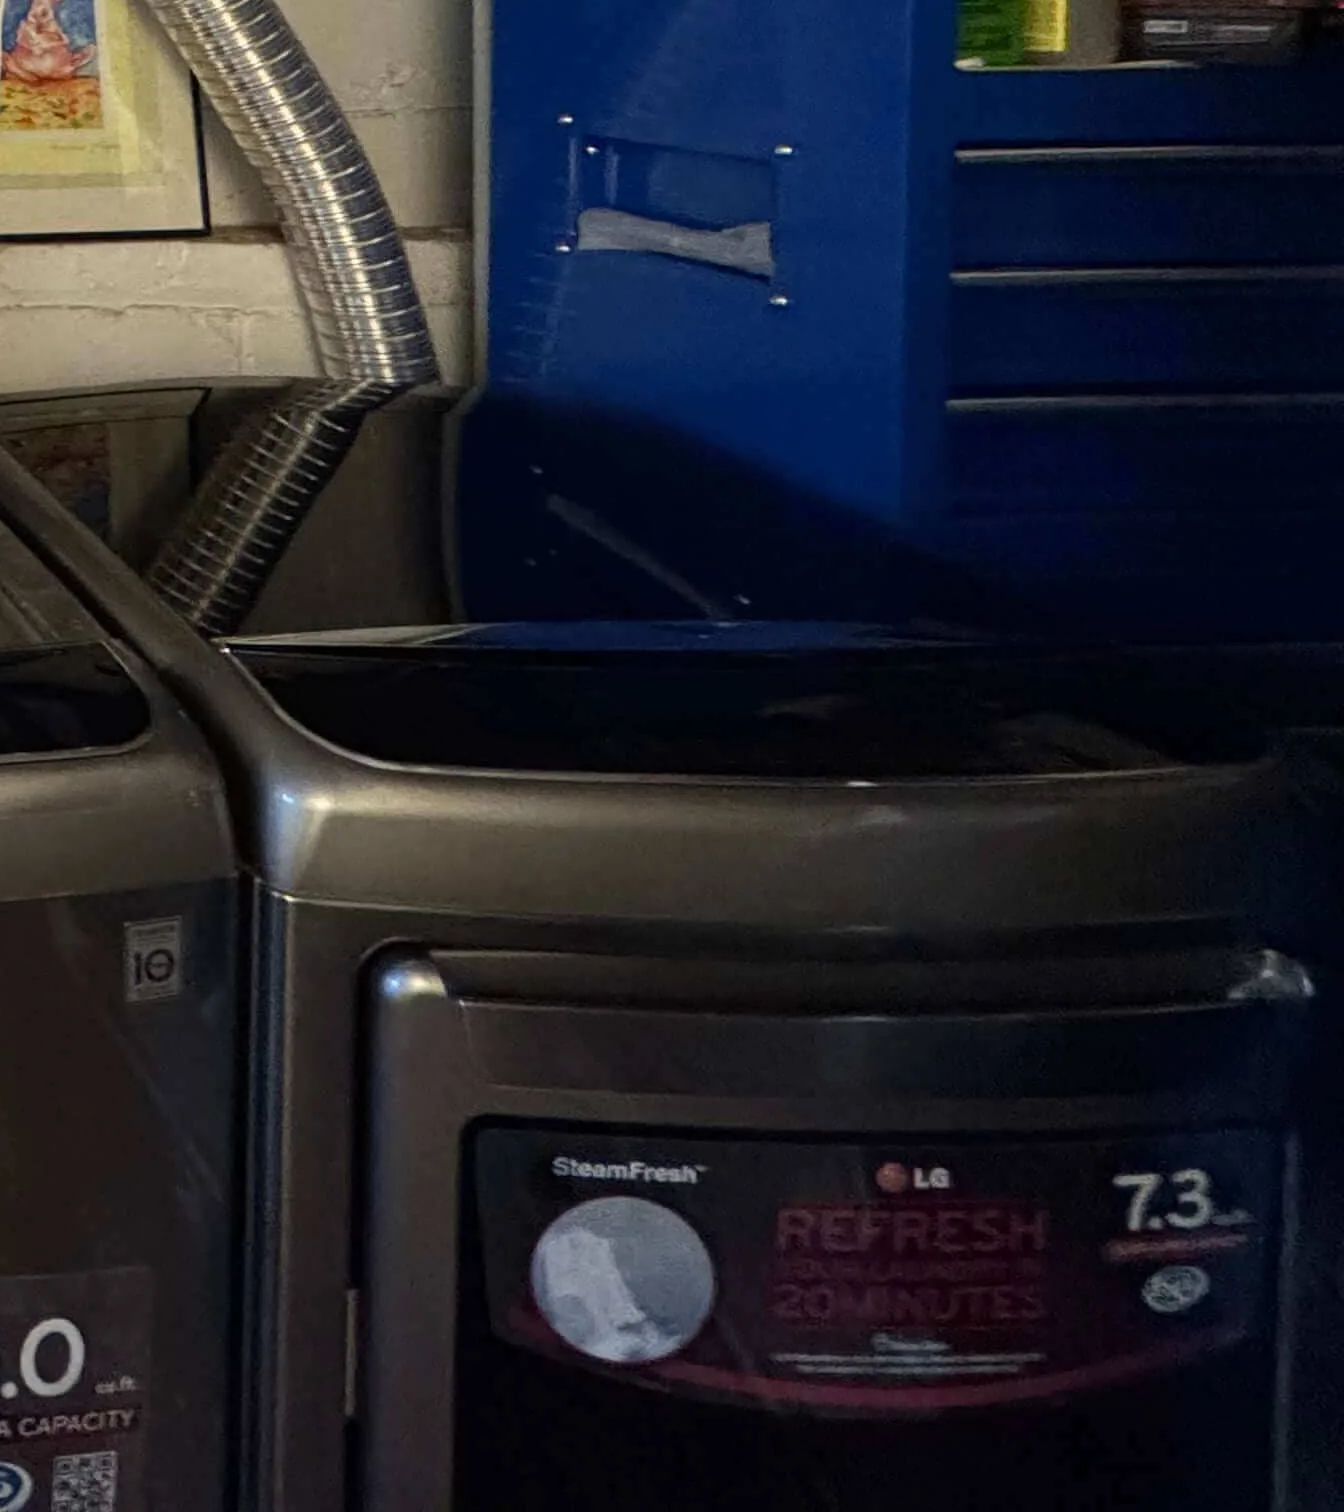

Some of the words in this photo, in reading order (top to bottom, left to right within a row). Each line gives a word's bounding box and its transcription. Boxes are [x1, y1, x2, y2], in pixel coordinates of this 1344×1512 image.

[551, 1155, 699, 1185] SteamFresh
[911, 1166, 952, 1190] LG
[1111, 1167, 1215, 1232] 7.3
[775, 1209, 1051, 1254] REFRESH
[773, 1283, 835, 1320] 20
[838, 1283, 1045, 1322] MINUTES
[17, 1408, 136, 1437] CAPACITY
